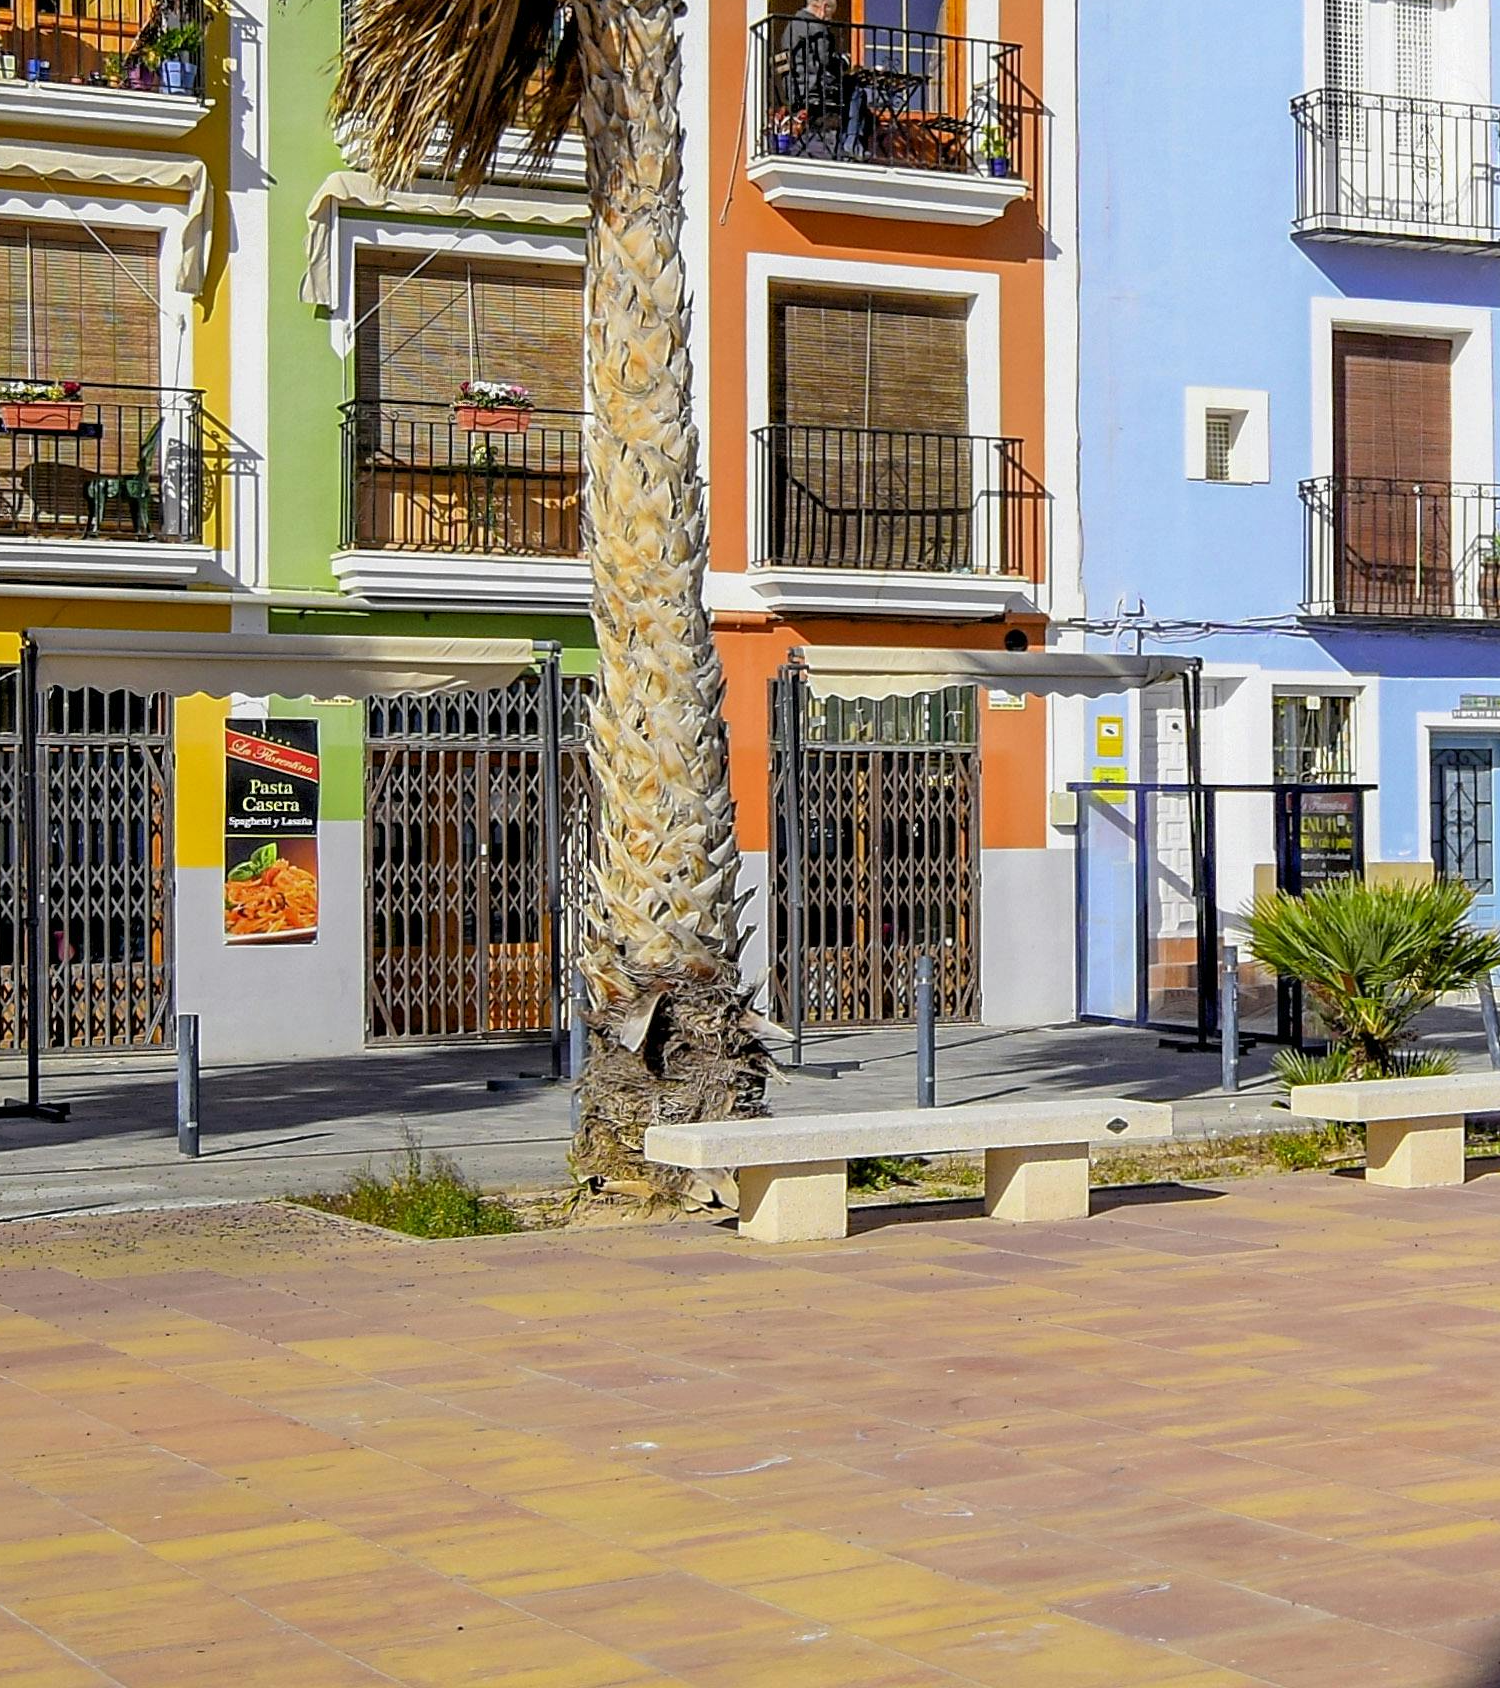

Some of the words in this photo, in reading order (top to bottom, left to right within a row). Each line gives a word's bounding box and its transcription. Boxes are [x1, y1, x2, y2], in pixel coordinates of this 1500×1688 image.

[228, 739, 251, 755] La
[252, 745, 314, 774] Florentina
[249, 779, 294, 794] Pasta
[242, 797, 300, 812] Casera
[273, 818, 280, 829] y
